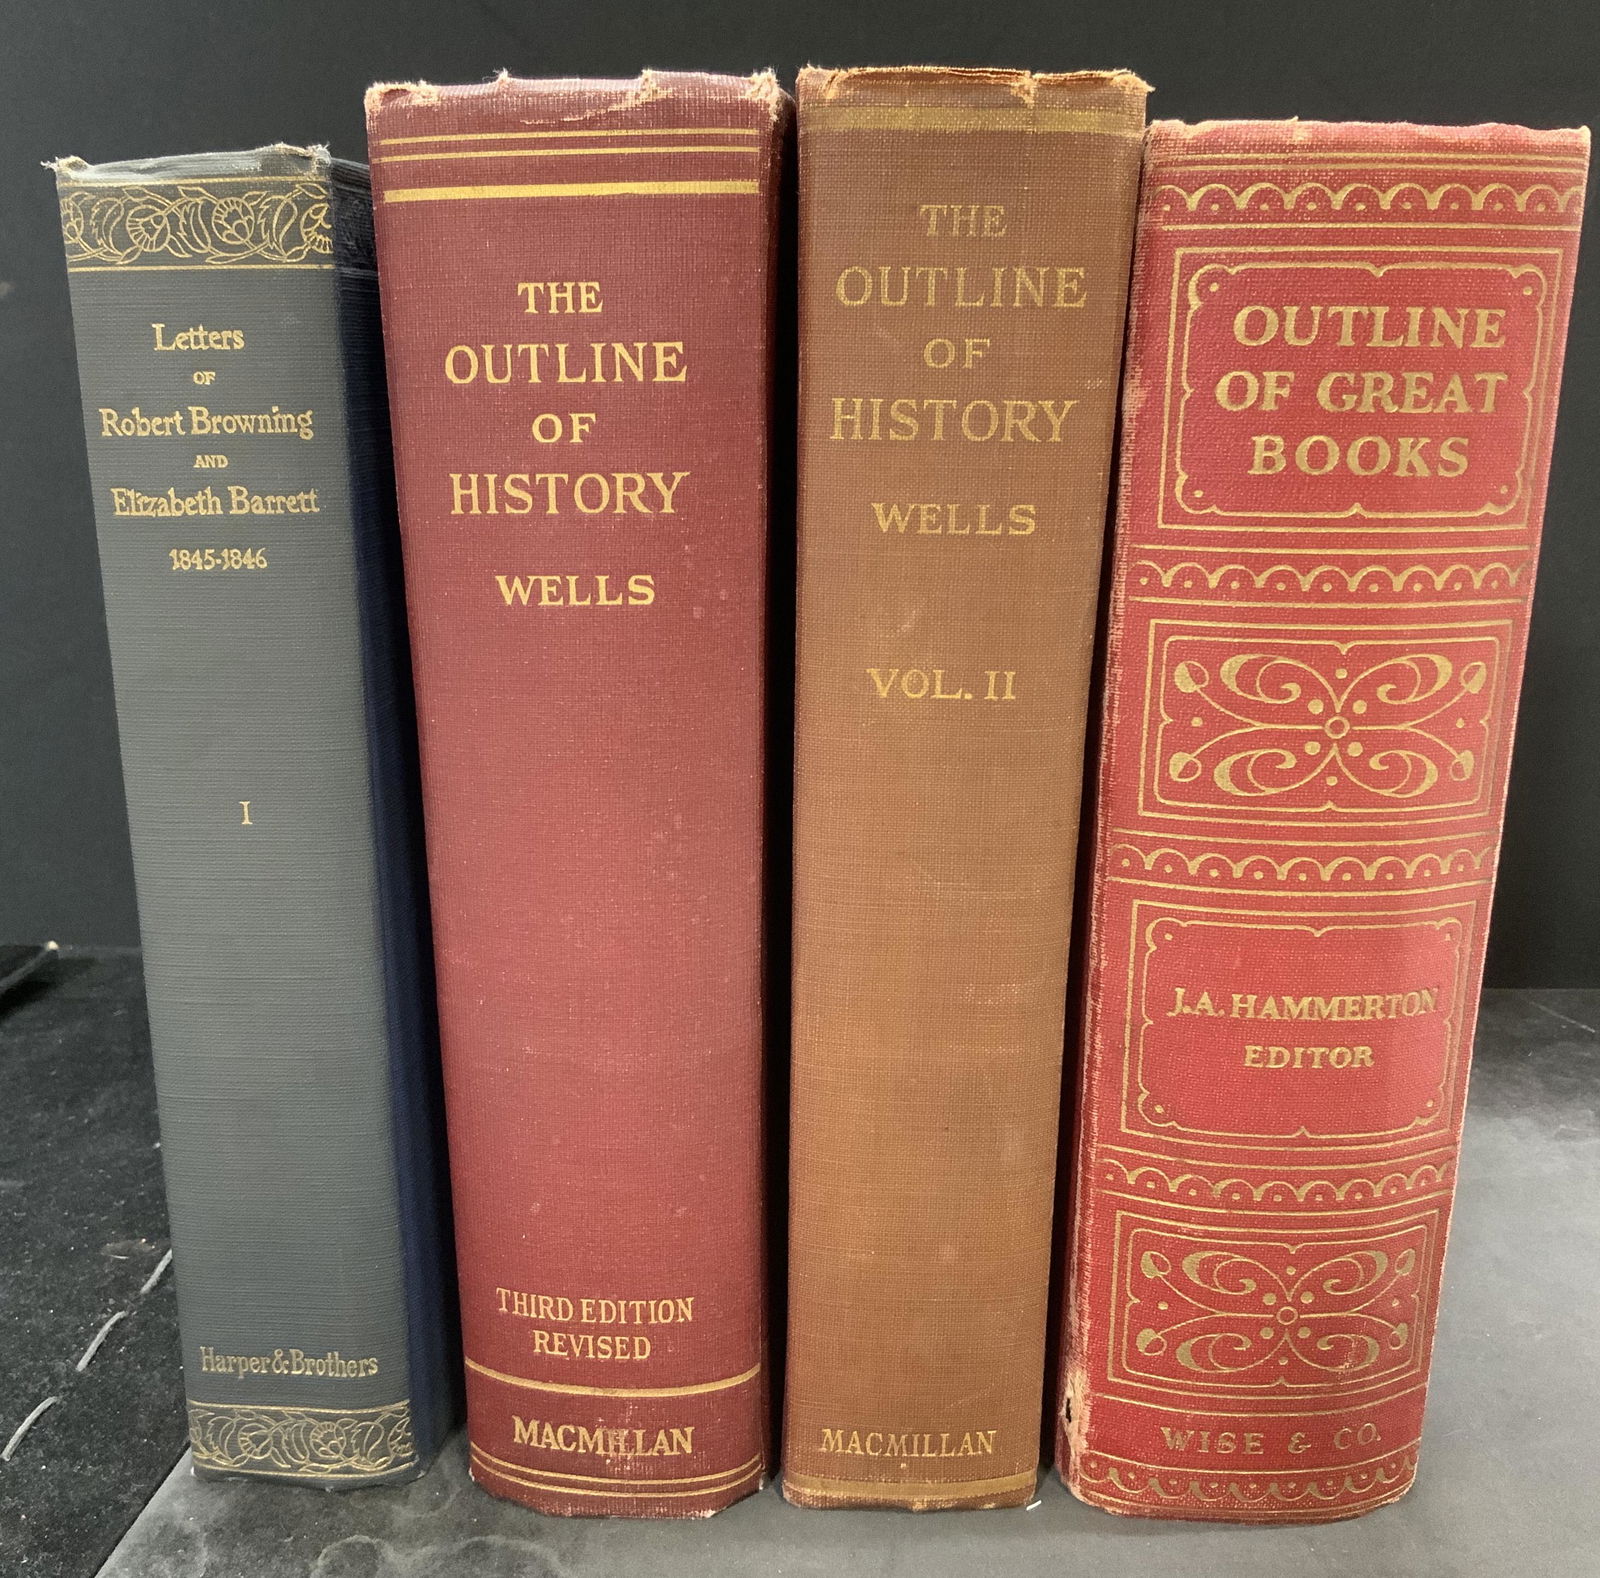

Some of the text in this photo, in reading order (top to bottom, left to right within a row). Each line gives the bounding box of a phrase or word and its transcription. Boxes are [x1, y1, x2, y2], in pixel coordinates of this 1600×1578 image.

[920, 205, 1008, 237] THE
[517, 281, 604, 314] THE
[835, 266, 1087, 308] OUTLINE
[152, 323, 245, 351] Letters
[1233, 305, 1506, 349] OUTLINE
[444, 341, 688, 384] OUTLINE
[923, 338, 991, 369] OF
[193, 371, 216, 385] OF
[1214, 370, 1508, 414] OF GREAT
[99, 406, 314, 440] Robert Browning
[531, 413, 596, 443] OF
[829, 397, 1080, 443] HISTORY
[193, 454, 229, 469] AND
[1247, 435, 1470, 477] BOOKS
[110, 486, 320, 517] Elizabeth Barrett
[449, 471, 691, 515] HISTORY
[871, 502, 1037, 535] WELLS
[169, 548, 268, 570] 1845-1846
[495, 574, 656, 606] WELLS
[866, 668, 1016, 701] VOL. II
[239, 801, 253, 825] I
[1229, 986, 1439, 1021] HAMMERTON
[1243, 1045, 1375, 1069] EDITOR
[496, 1287, 695, 1324] THIRD EDITION
[532, 1330, 651, 1360] REVISED
[512, 1415, 695, 1456] MACMILLAN
[821, 1428, 997, 1457] MACMILLAN
[1160, 1426, 1265, 1455] WISE
[1287, 1432, 1312, 1455] &
